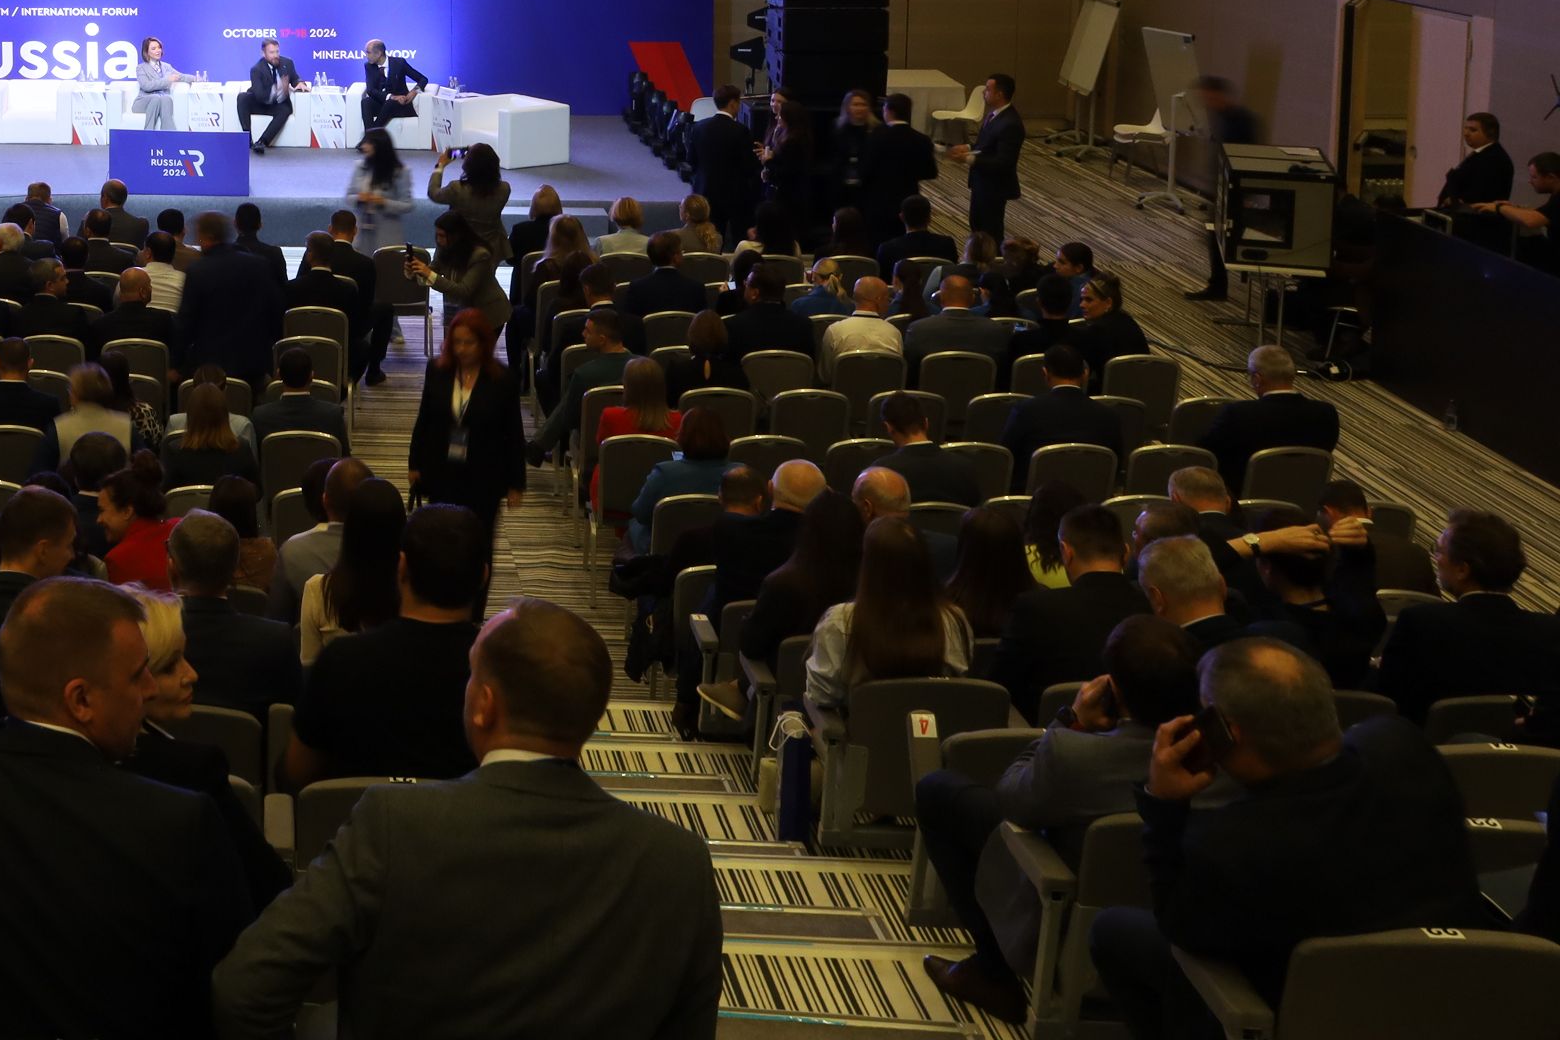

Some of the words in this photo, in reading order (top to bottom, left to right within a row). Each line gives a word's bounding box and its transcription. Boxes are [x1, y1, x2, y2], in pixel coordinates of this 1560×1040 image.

[21, 7, 100, 16] INTERNATIONAL
[102, 7, 138, 16] FORUM
[223, 29, 277, 38] OCTOBER
[309, 29, 337, 38] 2024
